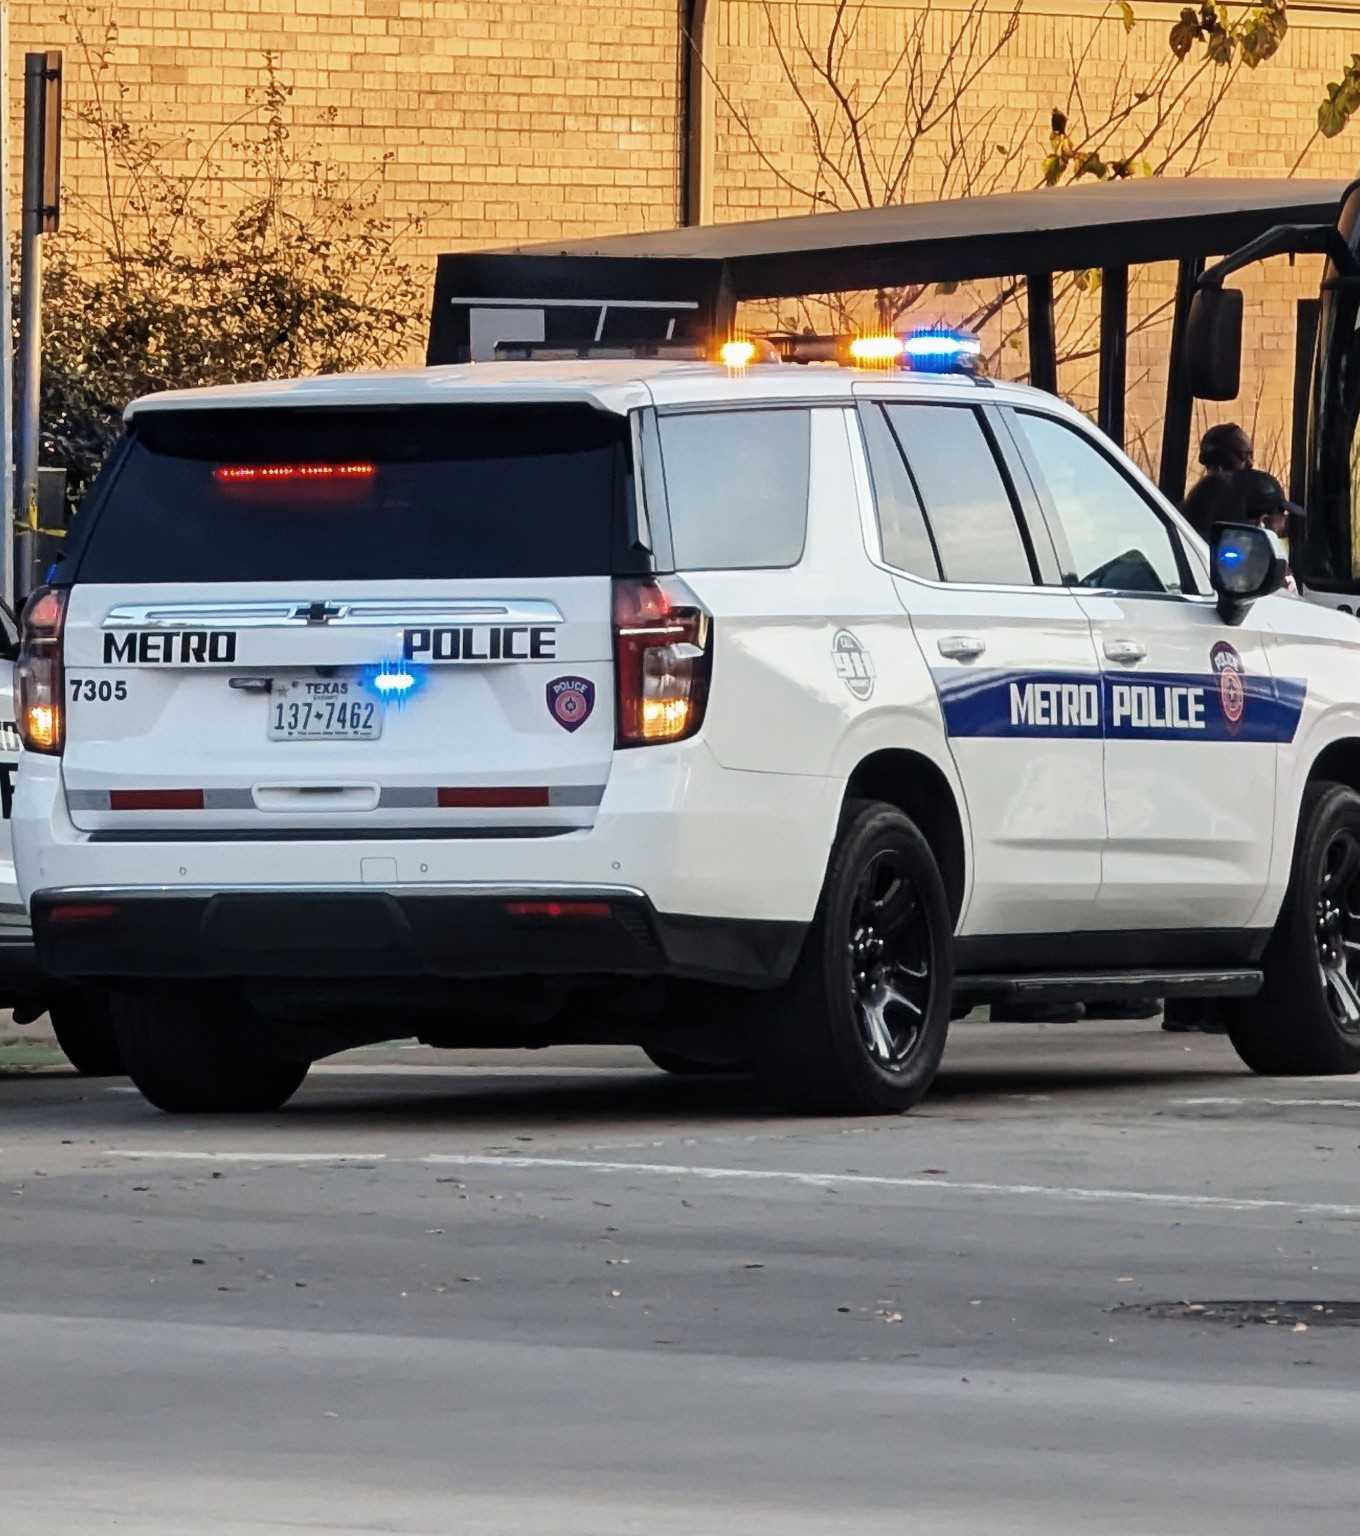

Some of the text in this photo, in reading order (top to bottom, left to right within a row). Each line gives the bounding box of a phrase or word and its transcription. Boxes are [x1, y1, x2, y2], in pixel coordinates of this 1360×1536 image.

[103, 627, 556, 664] METRO POLICE
[70, 679, 127, 702] 7305
[305, 683, 348, 694] TEXAS
[553, 680, 588, 695] POLICE
[1010, 682, 1206, 729] METRO POLICE
